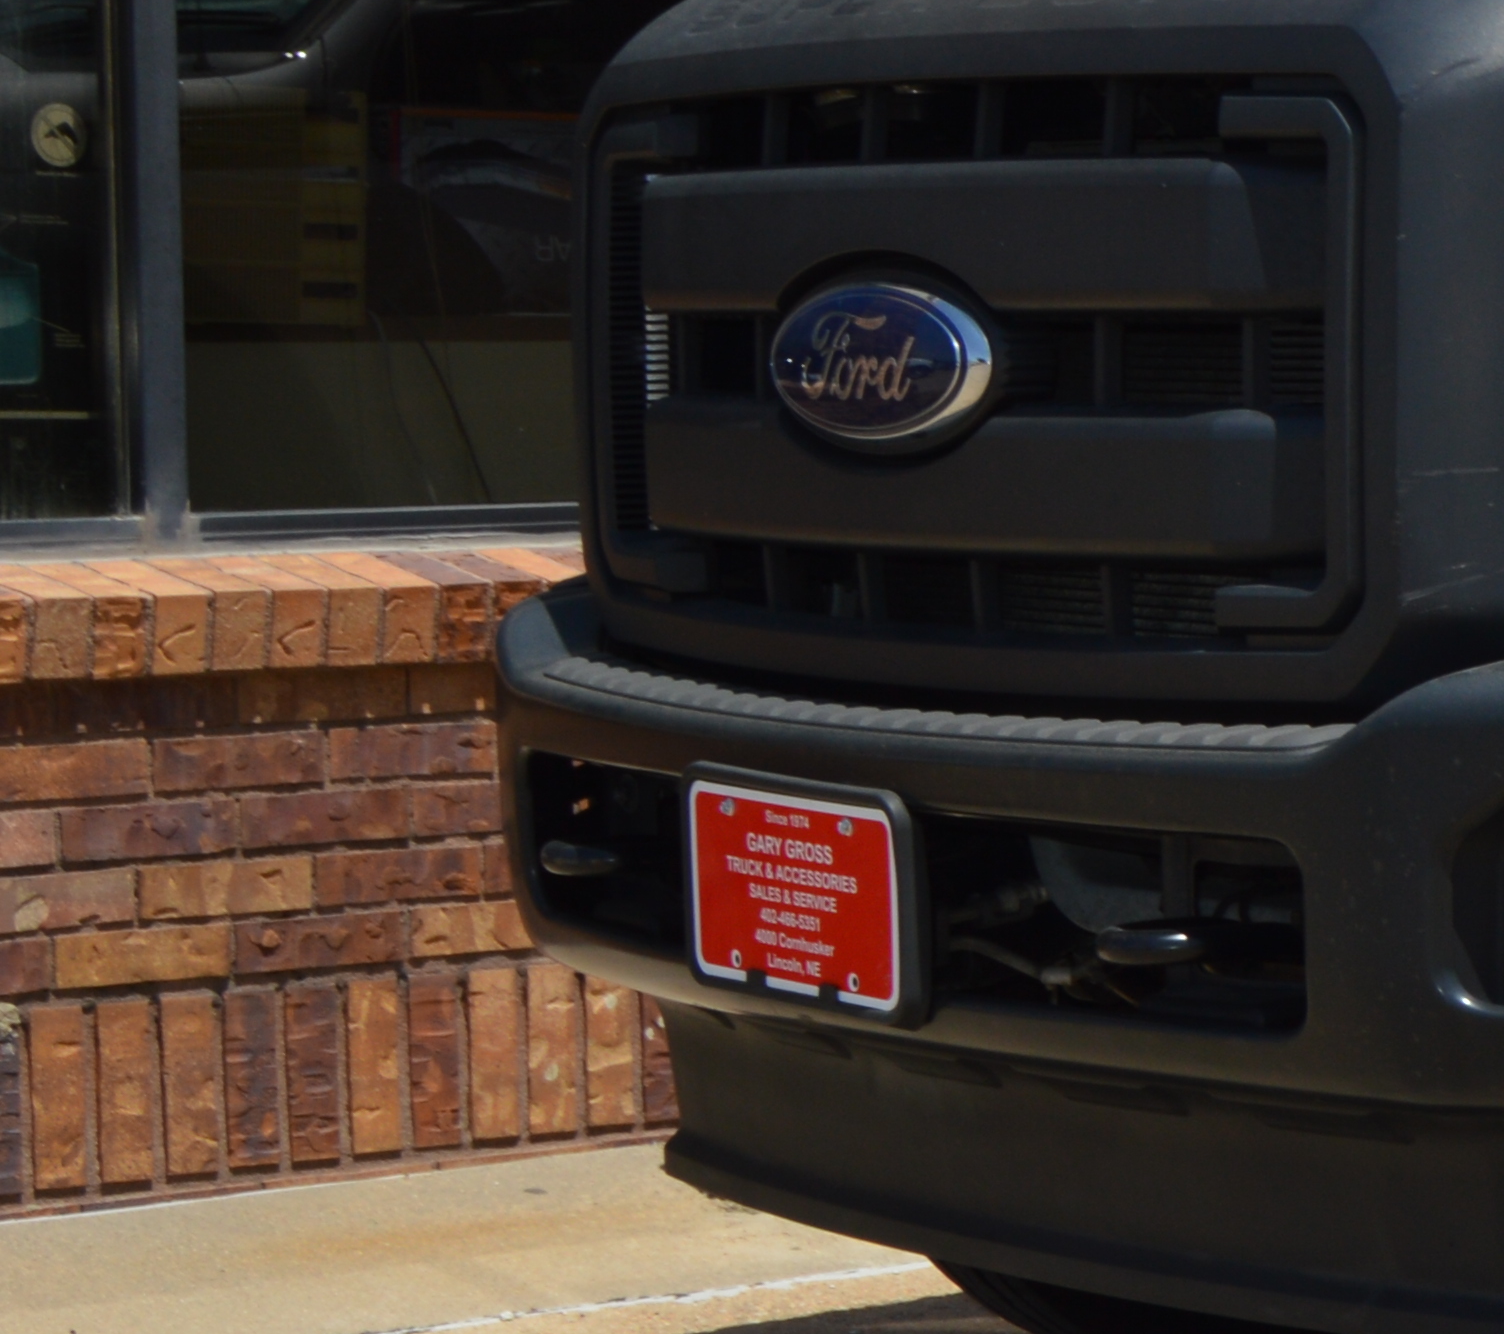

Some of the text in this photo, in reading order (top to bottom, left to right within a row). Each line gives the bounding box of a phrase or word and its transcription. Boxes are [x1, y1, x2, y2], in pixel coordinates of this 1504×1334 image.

[800, 310, 933, 402] Ford
[764, 809, 788, 826] Since
[746, 832, 834, 866] GARY GROSS
[726, 855, 858, 895] TRUCK & ACCESSORIES
[749, 882, 838, 914] SALES & SERVICE
[766, 952, 822, 978] Lincoln, NE
